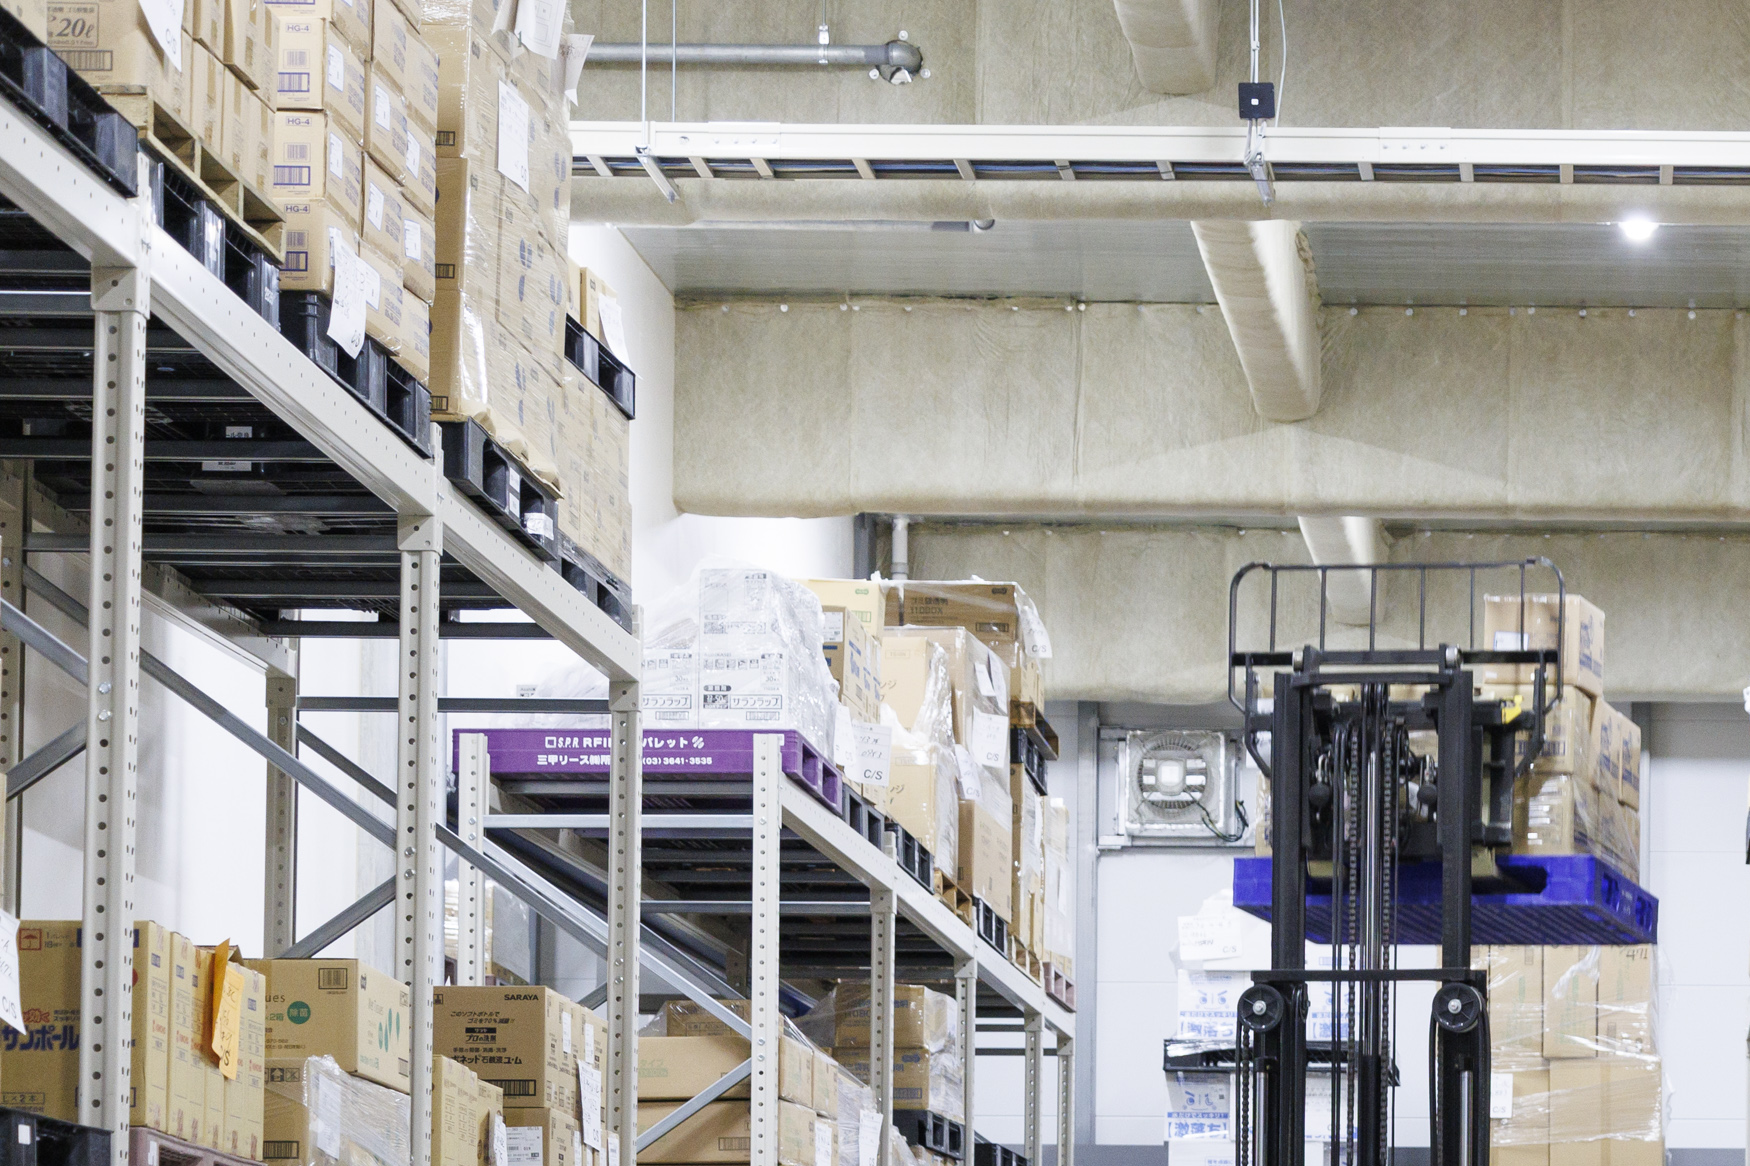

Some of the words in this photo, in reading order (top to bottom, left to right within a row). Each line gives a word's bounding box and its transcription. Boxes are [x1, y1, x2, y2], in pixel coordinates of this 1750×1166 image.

[285, 205, 308, 213] HG-4
[733, 697, 779, 706] サランラップ
[863, 769, 883, 781] C/S
